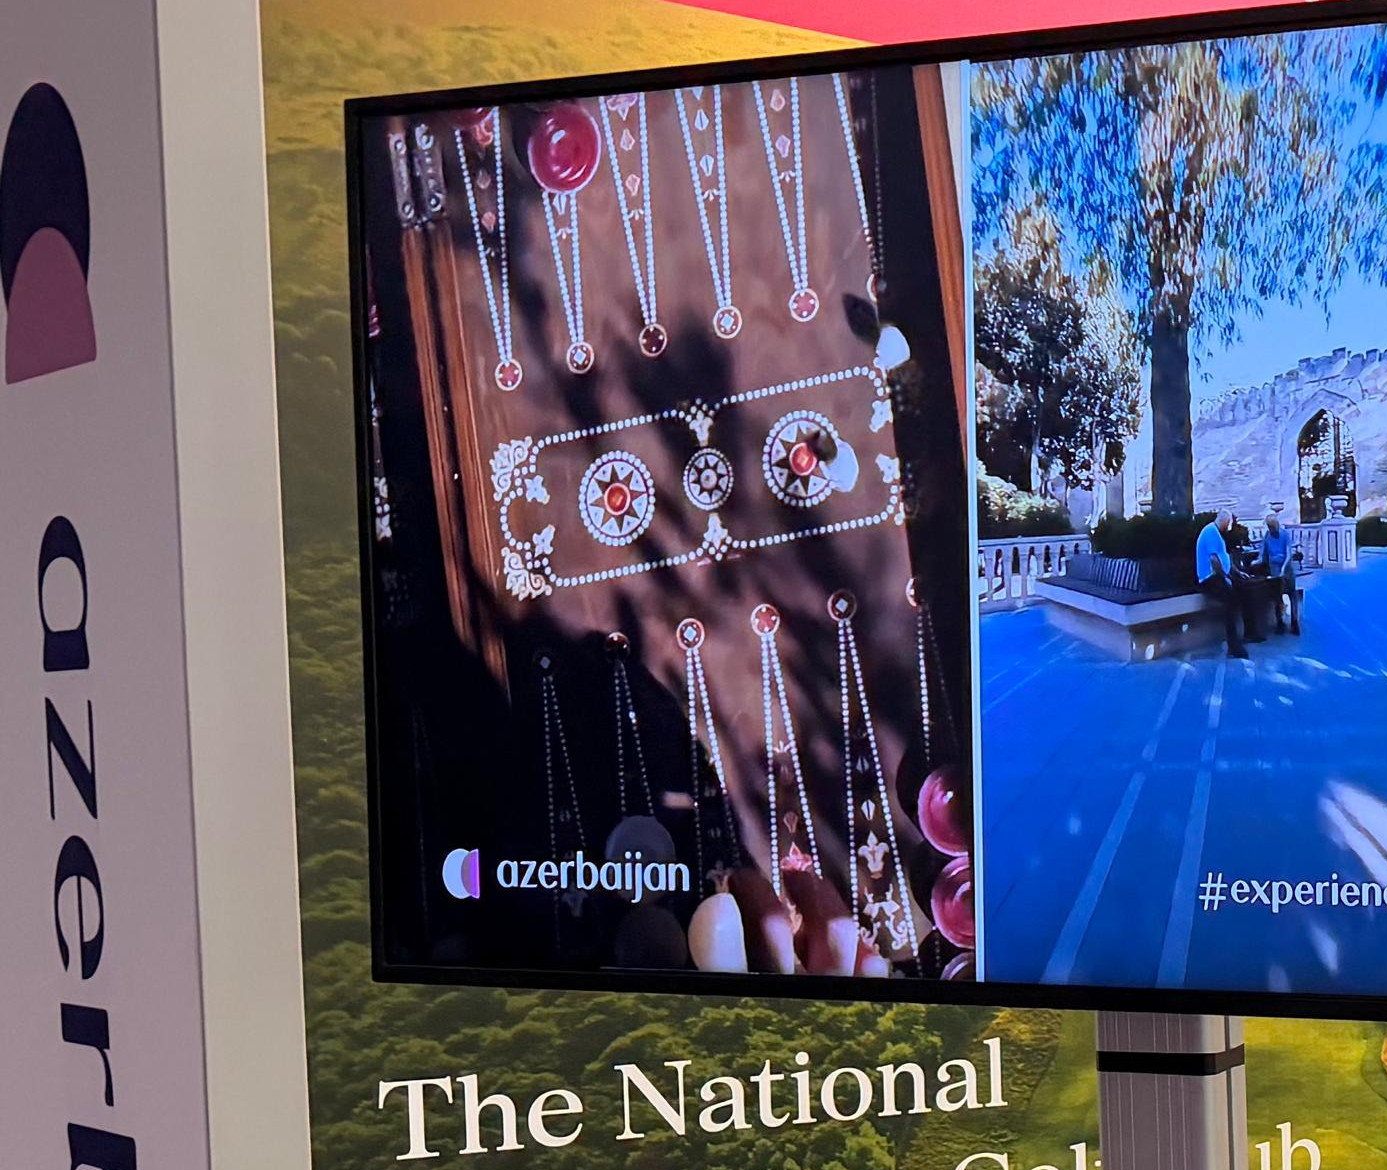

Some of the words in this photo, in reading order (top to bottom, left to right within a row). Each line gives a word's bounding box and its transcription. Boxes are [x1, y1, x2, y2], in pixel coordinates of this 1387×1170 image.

[496, 850, 690, 904] azerbaijan
[377, 1073, 584, 1161] The
[615, 1037, 1010, 1141] National
